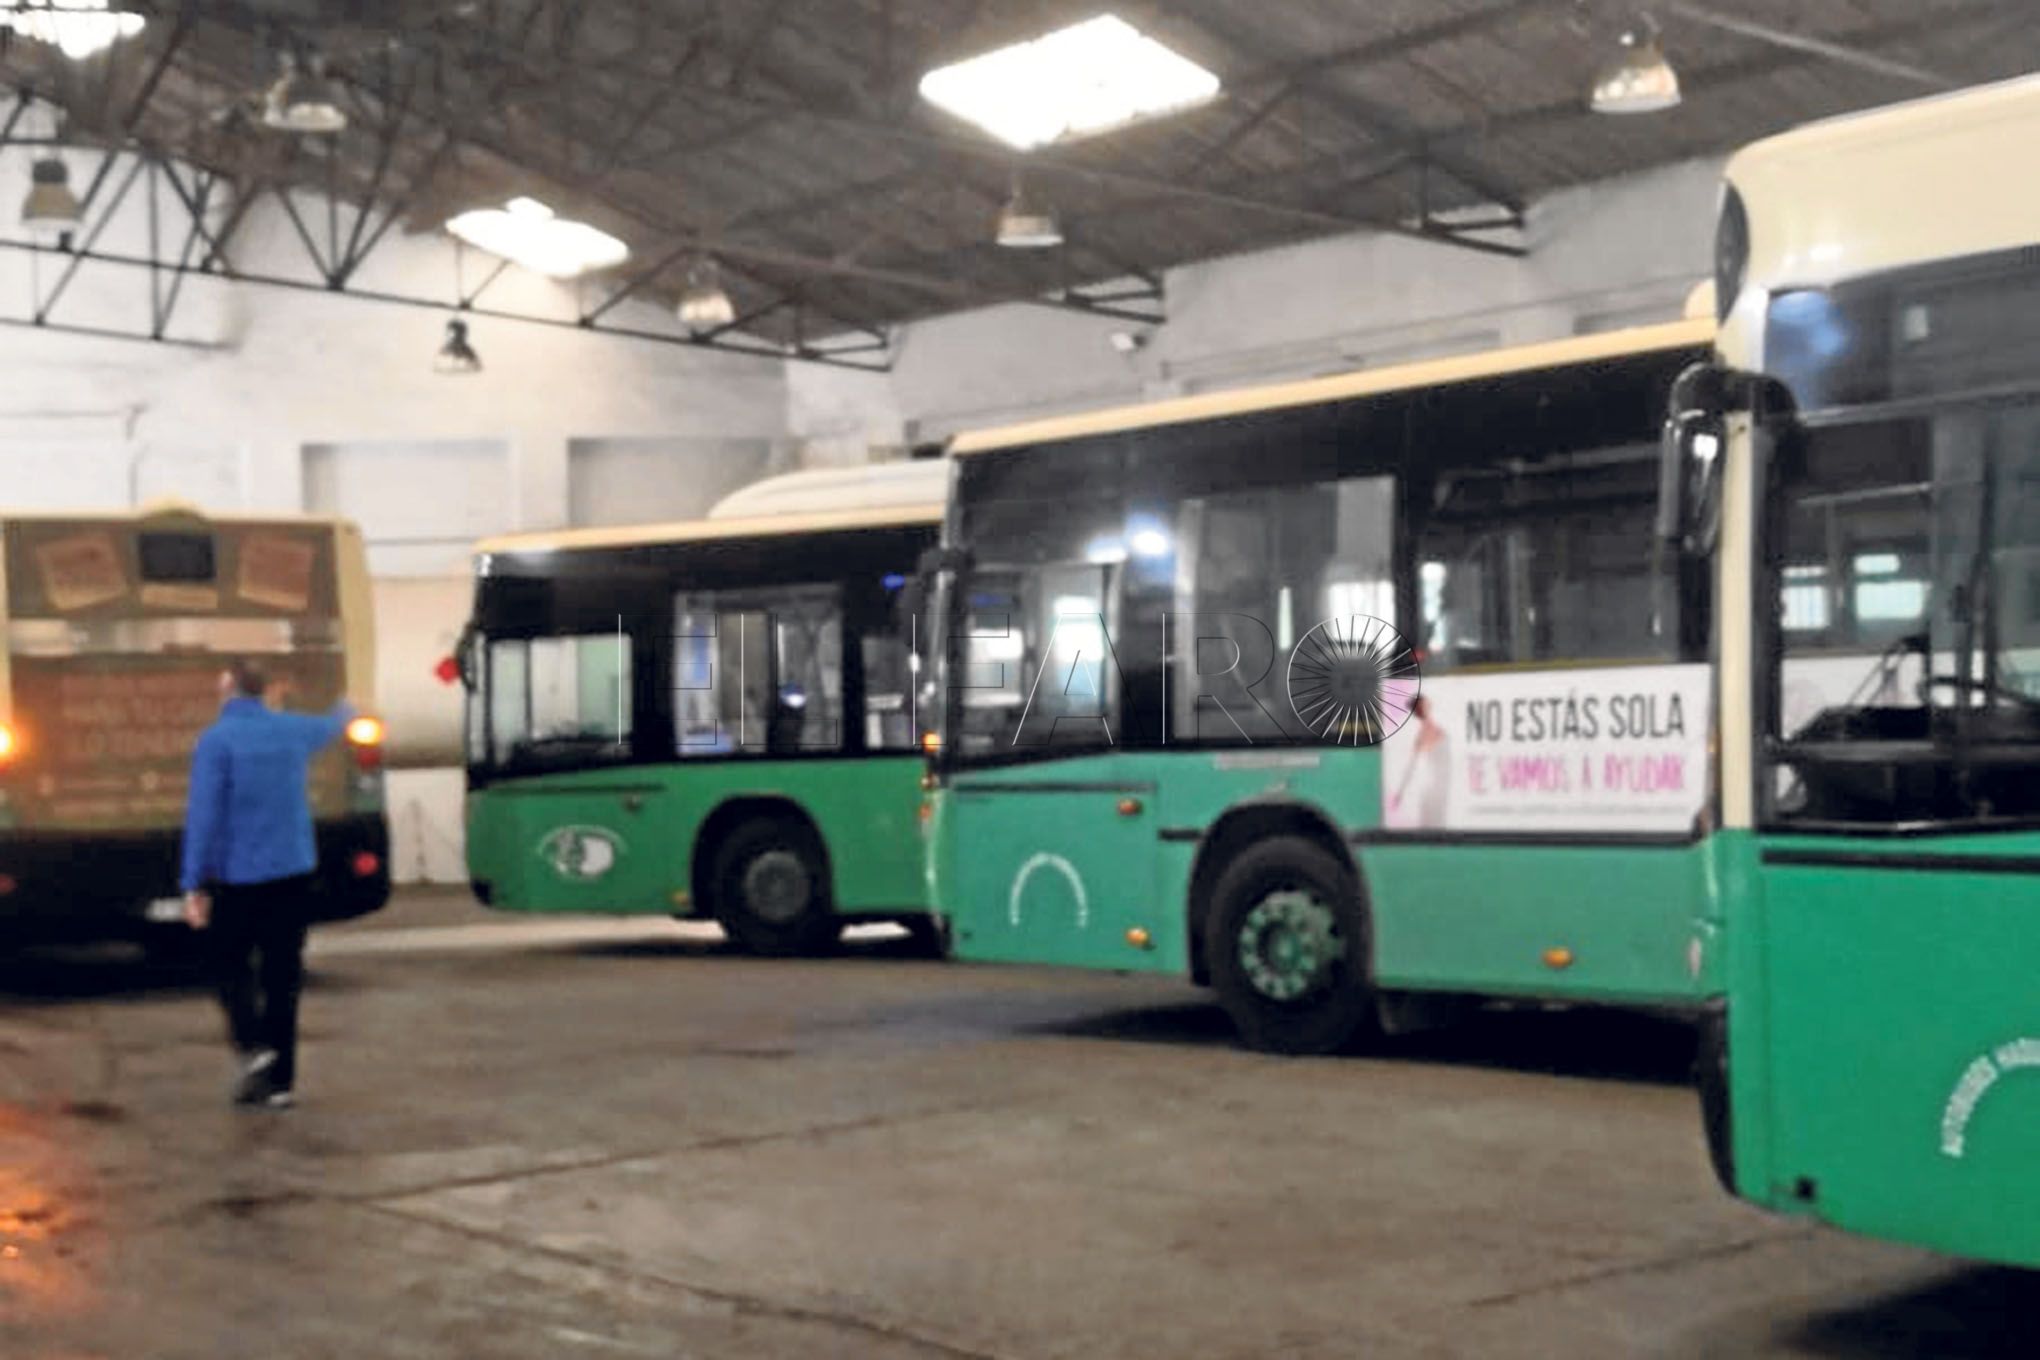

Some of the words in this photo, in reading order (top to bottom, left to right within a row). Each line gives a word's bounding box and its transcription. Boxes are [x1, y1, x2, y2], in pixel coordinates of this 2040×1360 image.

[1466, 699, 1502, 743] NO
[1511, 686, 1600, 742] ESTÁS
[1608, 691, 1687, 740] SOLA
[1467, 755, 1488, 794] TE
[1496, 753, 1570, 792] VAMOS
[1581, 753, 1593, 789] A
[1603, 751, 1685, 791] AYUDAR
